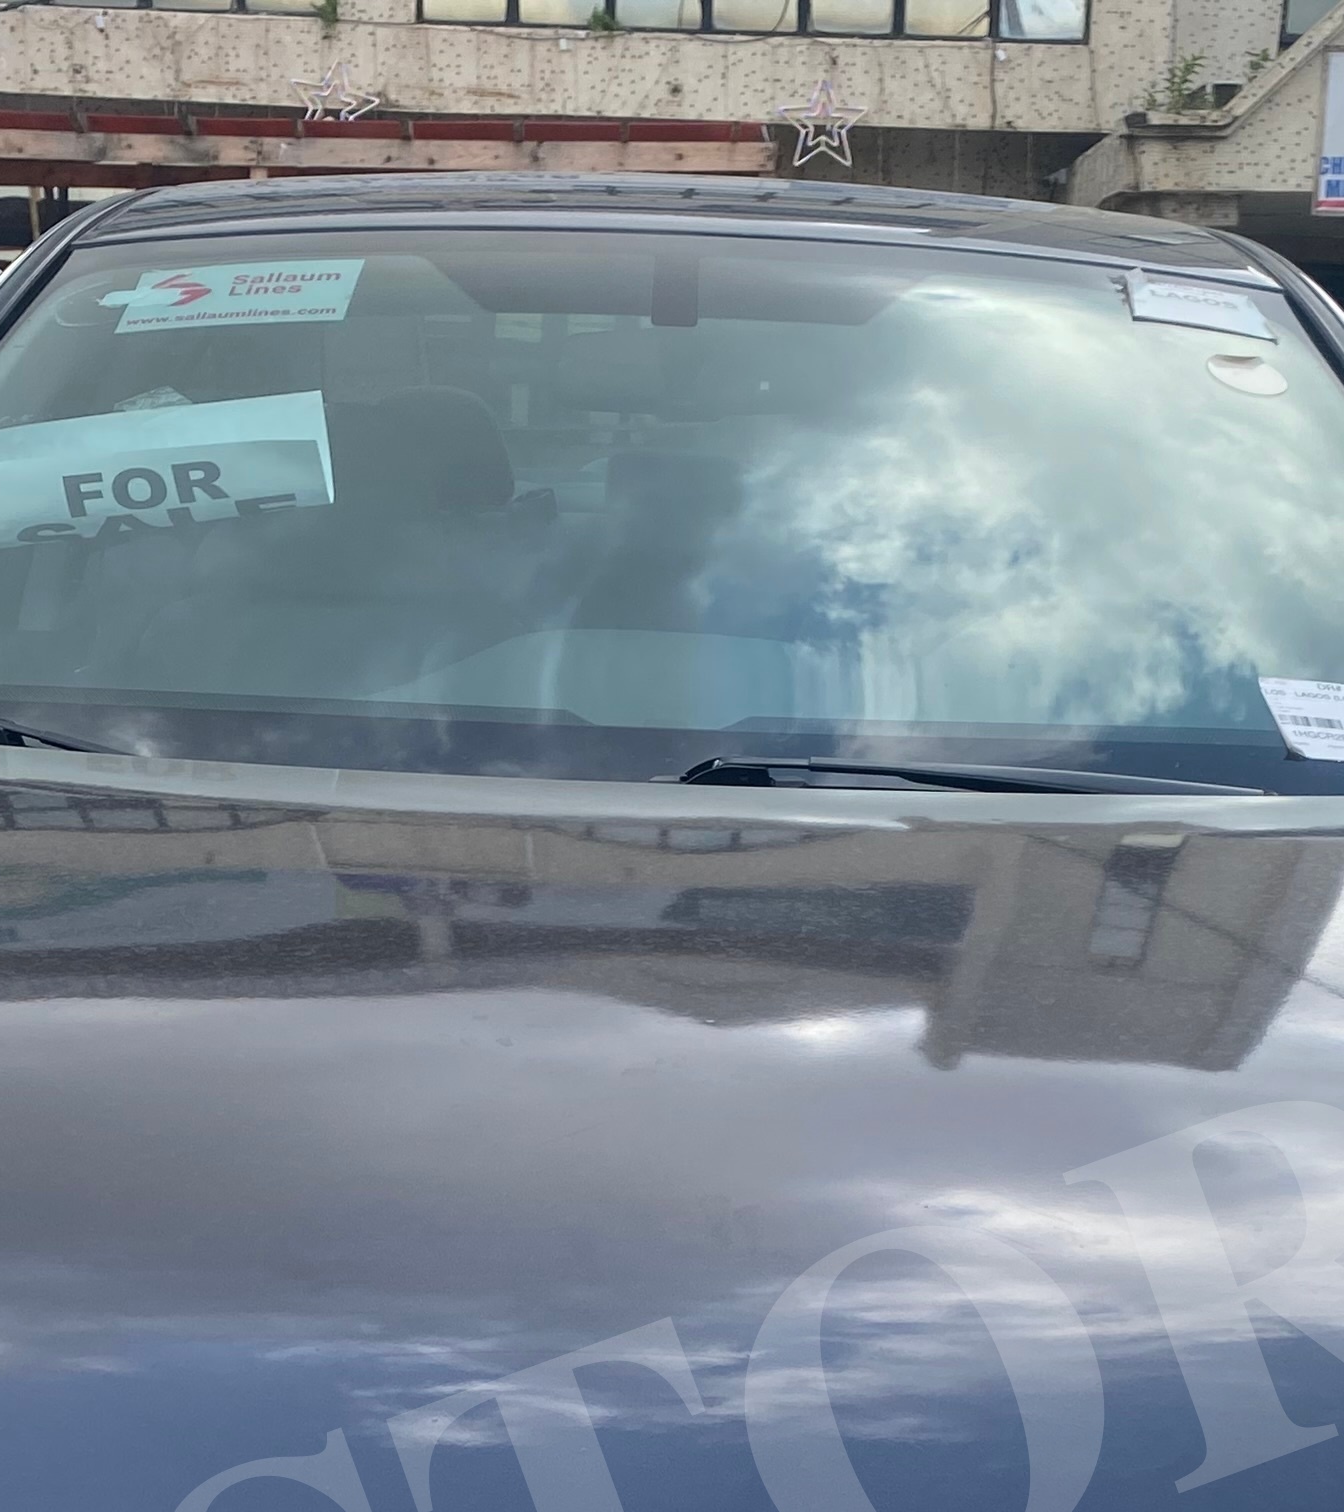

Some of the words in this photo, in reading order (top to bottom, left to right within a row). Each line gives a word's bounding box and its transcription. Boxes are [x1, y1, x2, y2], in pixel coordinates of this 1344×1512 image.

[232, 270, 342, 285] Sallaum
[227, 283, 302, 298] Lines
[125, 306, 338, 327] www.sallaumlines.com
[62, 460, 230, 519] FOR
